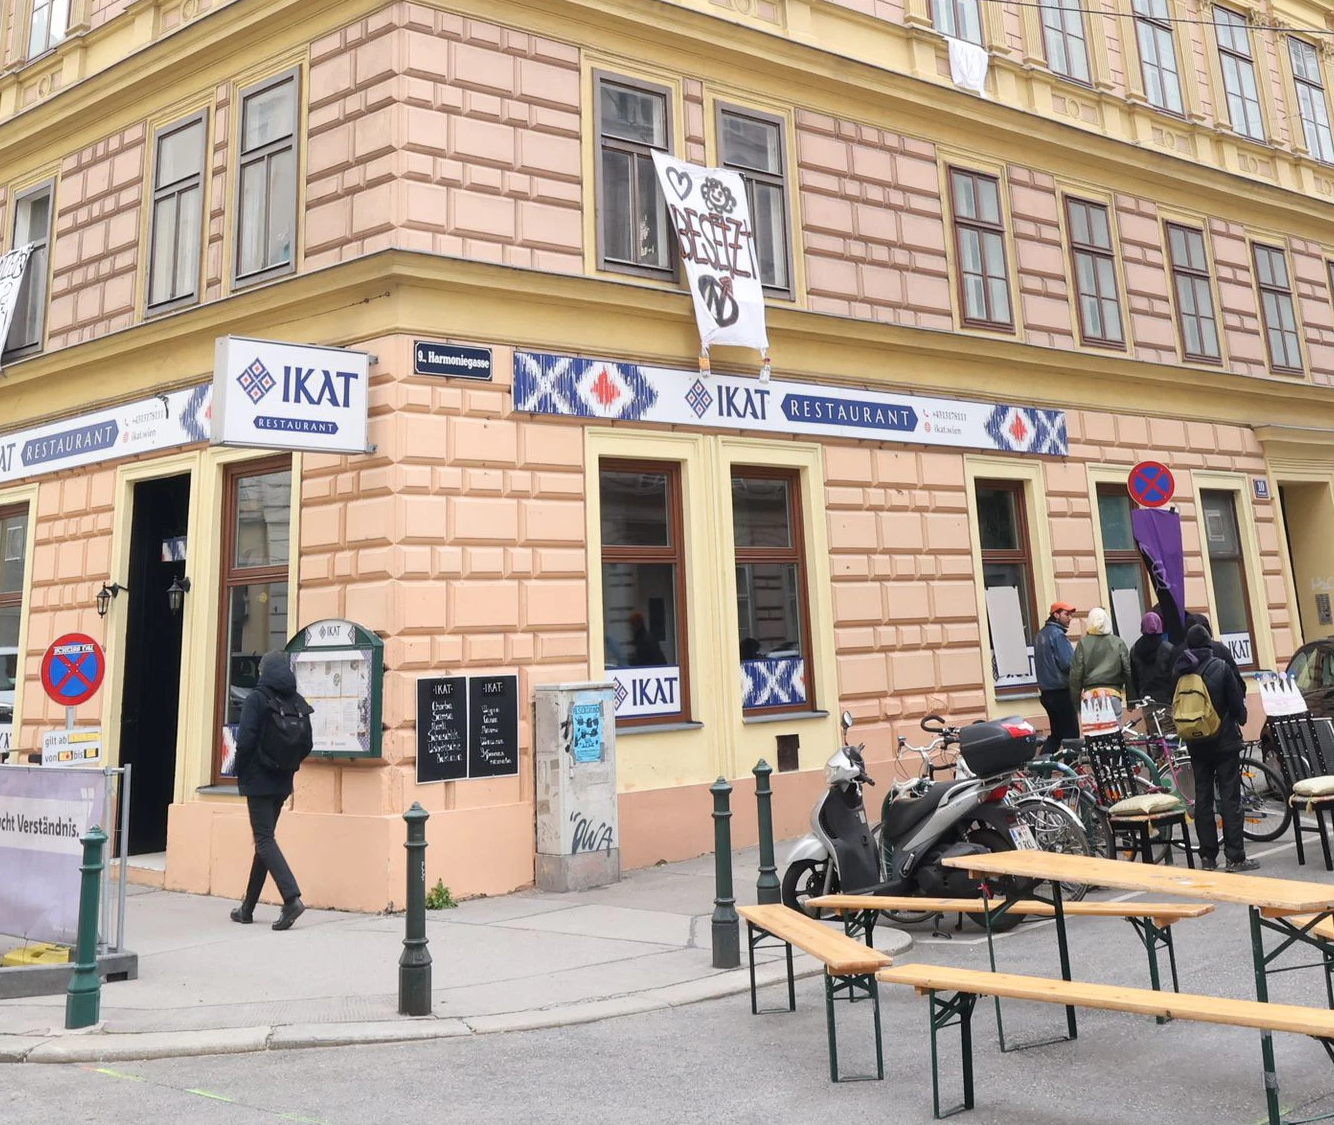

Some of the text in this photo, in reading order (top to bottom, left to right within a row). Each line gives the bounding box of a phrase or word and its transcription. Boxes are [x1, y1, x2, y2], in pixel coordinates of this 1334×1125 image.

[428, 351, 489, 370] Harmoniegasse
[282, 365, 359, 408] IKAT
[717, 385, 910, 426] IKAT RESTAURANT
[258, 418, 334, 433] RESTAURANT
[26, 426, 113, 461] RESTAURANT
[327, 625, 341, 635] IKAT
[434, 684, 451, 695] IKAT
[484, 682, 502, 693] IKAT
[632, 677, 678, 706] IKAT
[44, 734, 67, 747] gilt ab
[45, 750, 84, 763] von bis
[17, 814, 80, 838] Verständnis.
